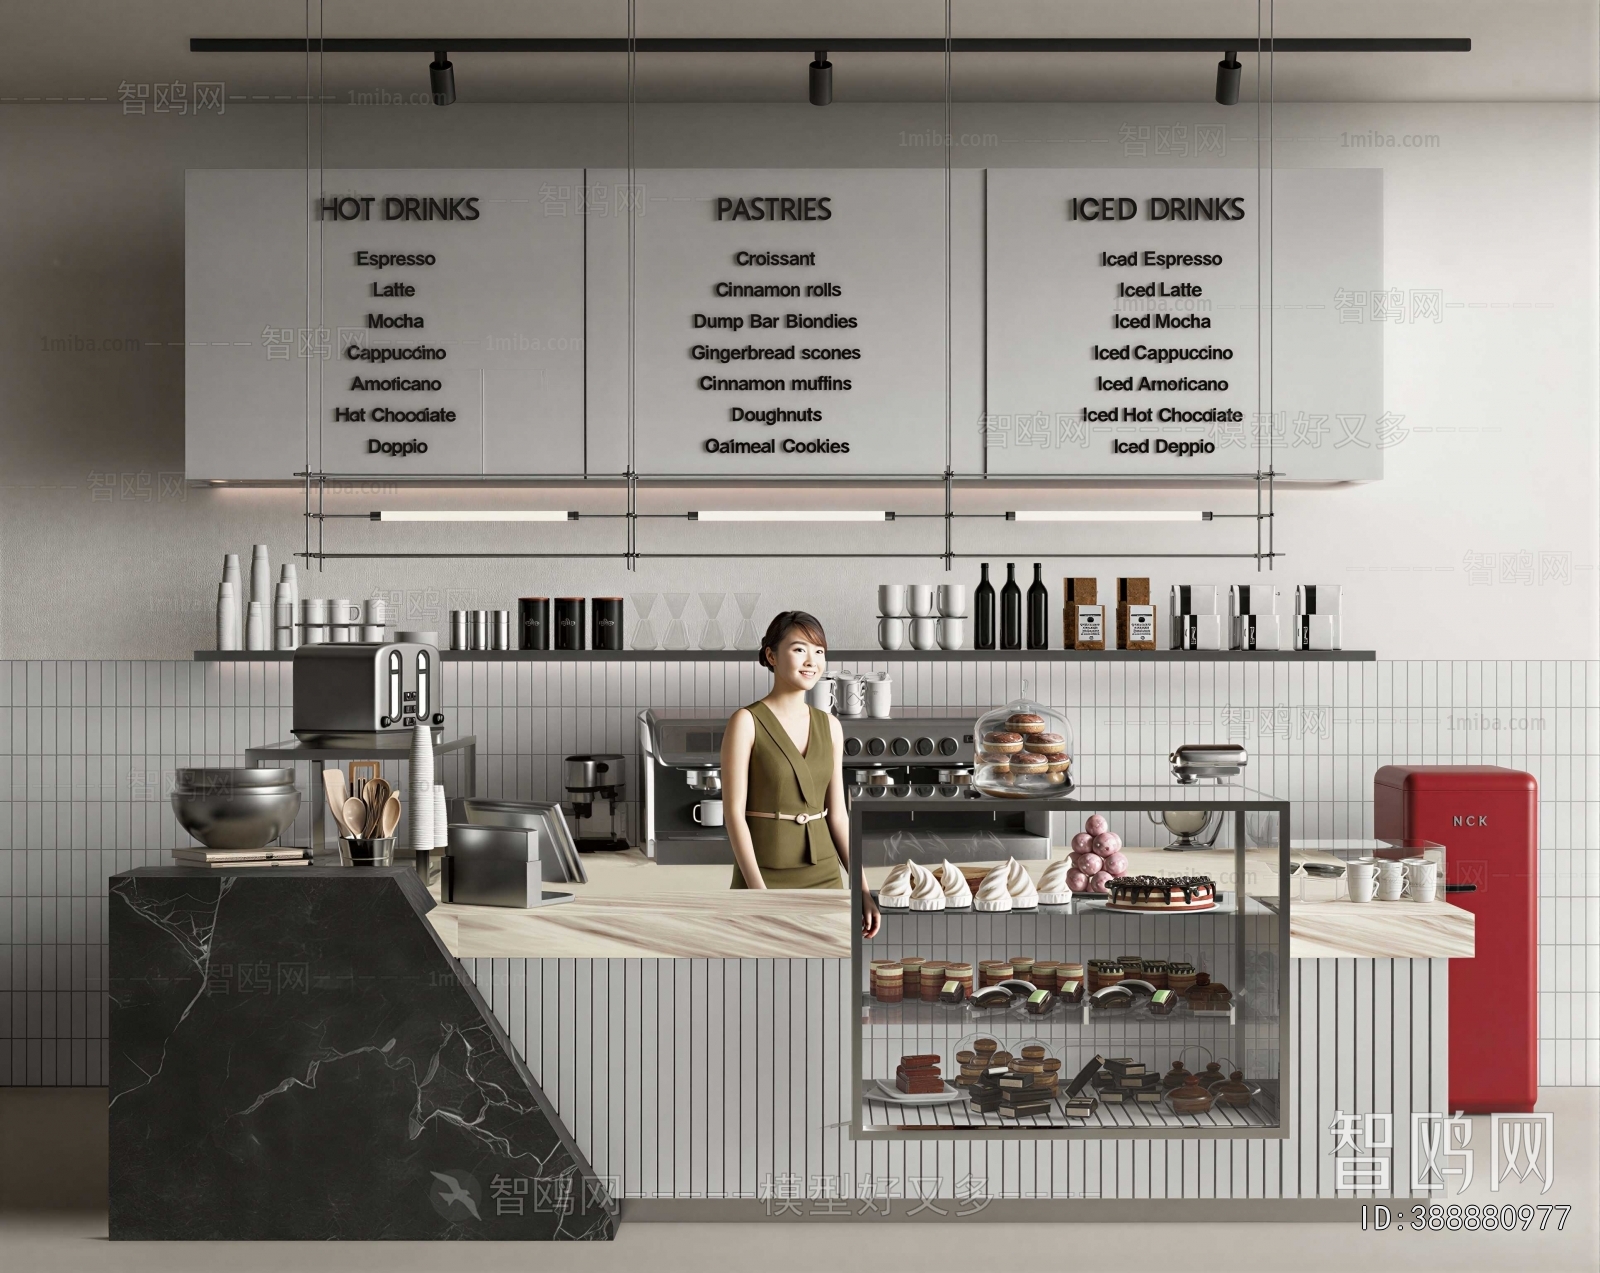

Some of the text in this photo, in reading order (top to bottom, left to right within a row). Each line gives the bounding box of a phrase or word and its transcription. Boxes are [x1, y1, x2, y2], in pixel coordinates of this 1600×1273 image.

[321, 197, 480, 221] HOT DRINKS
[717, 196, 832, 221] PASTRIES
[1072, 196, 1246, 221] ICED DRINKS
[356, 250, 436, 269] Espresso
[736, 250, 816, 266] Croissant
[1144, 250, 1223, 269] Espresso
[373, 281, 416, 297] Latte
[715, 281, 842, 297] Cinnamon rolls
[1120, 281, 1203, 297] Iced Latte
[368, 313, 425, 328] Mocha
[693, 313, 744, 331] Dump
[750, 313, 780, 328] Bar
[1115, 313, 1211, 329] Iced Mocha
[691, 345, 861, 363] Gingerbread scones
[1094, 345, 1233, 363] Iced Cappuccino
[699, 375, 852, 391] Cinnamon muffins
[1098, 376, 1133, 391] Iced
[732, 407, 822, 426] Doughnuts
[1083, 407, 1118, 422] Iced
[1123, 407, 1153, 422] Hot
[368, 438, 428, 457] Doppio
[782, 438, 850, 454] Cookies
[1114, 438, 1216, 457] Iced Deppio
[1453, 815, 1489, 827] NCK
